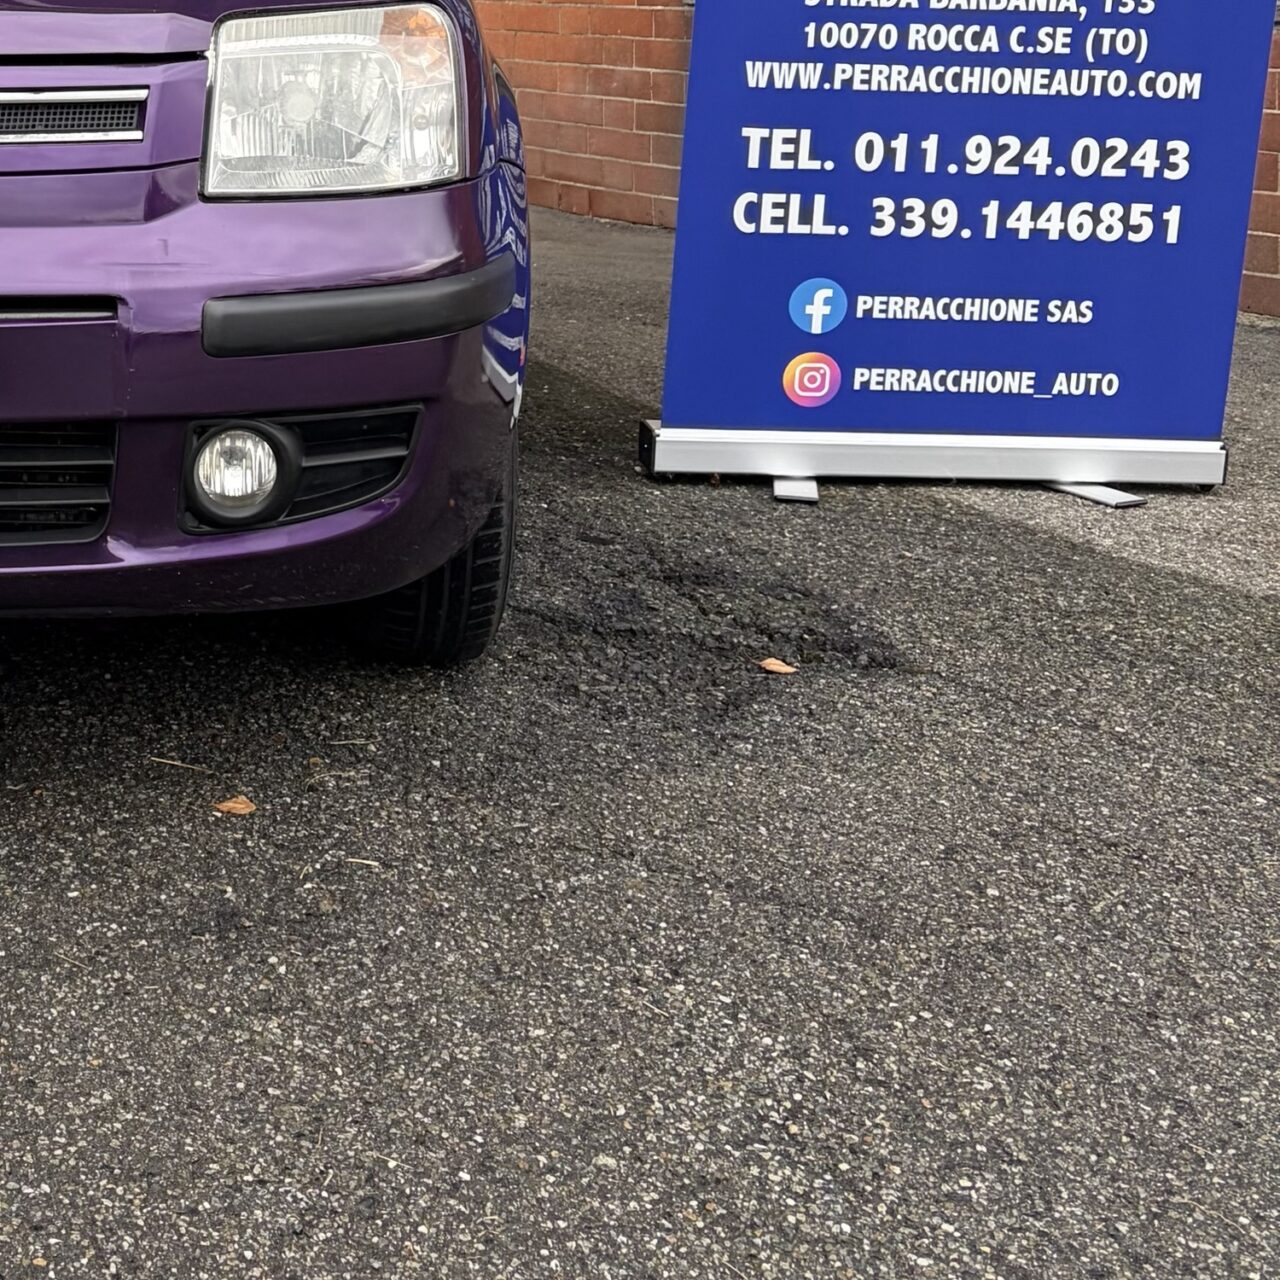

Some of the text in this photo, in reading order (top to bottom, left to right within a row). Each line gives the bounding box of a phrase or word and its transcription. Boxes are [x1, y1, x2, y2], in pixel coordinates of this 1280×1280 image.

[804, 22, 1149, 63] 10070 ROCCA C.SE (TO)
[745, 61, 1203, 100] WWW.PERRACCHIONEAUTO.COM
[741, 127, 1191, 180] TEL. 011.924.0243
[732, 192, 1182, 244] CELL. 339.1446851
[856, 295, 1094, 324] PERRACCHIONE SAS
[853, 367, 1120, 397] PERRACCHIONE_AUTO
